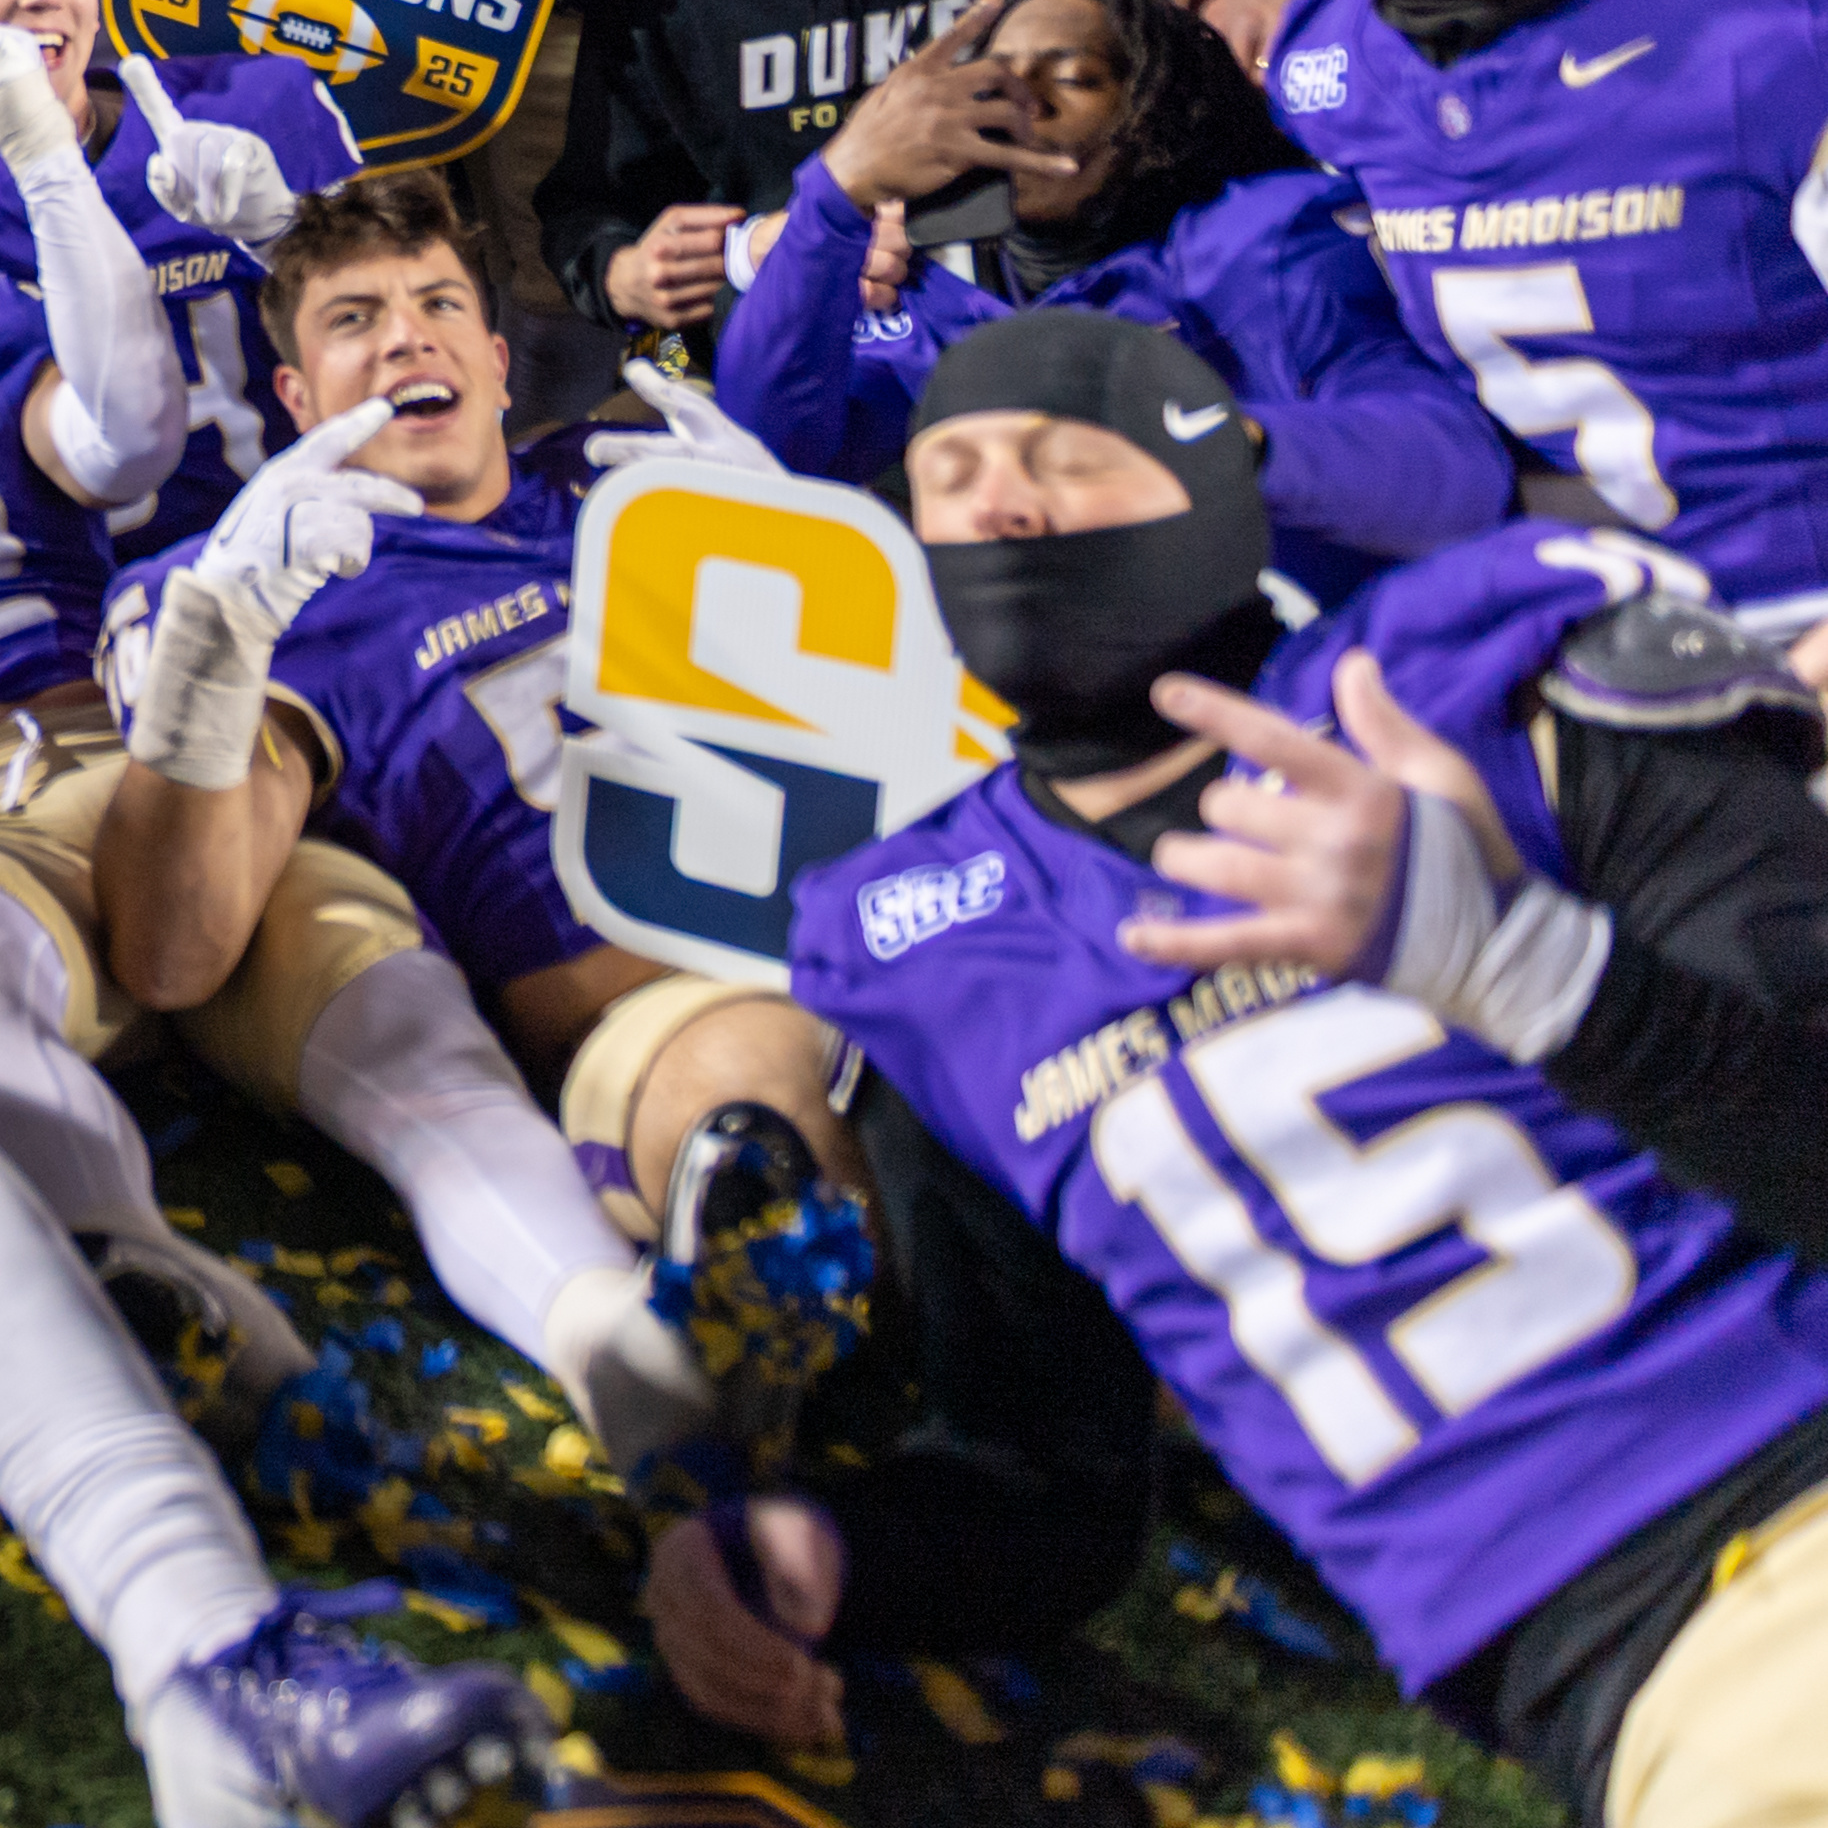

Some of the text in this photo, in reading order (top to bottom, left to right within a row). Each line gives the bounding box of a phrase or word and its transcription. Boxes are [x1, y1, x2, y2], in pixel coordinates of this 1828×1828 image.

[422, 55, 479, 98] 25
[1459, 183, 1686, 252] MADISON
[149, 252, 232, 295] ISON
[1431, 260, 1679, 530] 5
[415, 584, 549, 672] JAMES
[1014, 1006, 1170, 1143] JAMES
[1090, 980, 1639, 1488] 15
